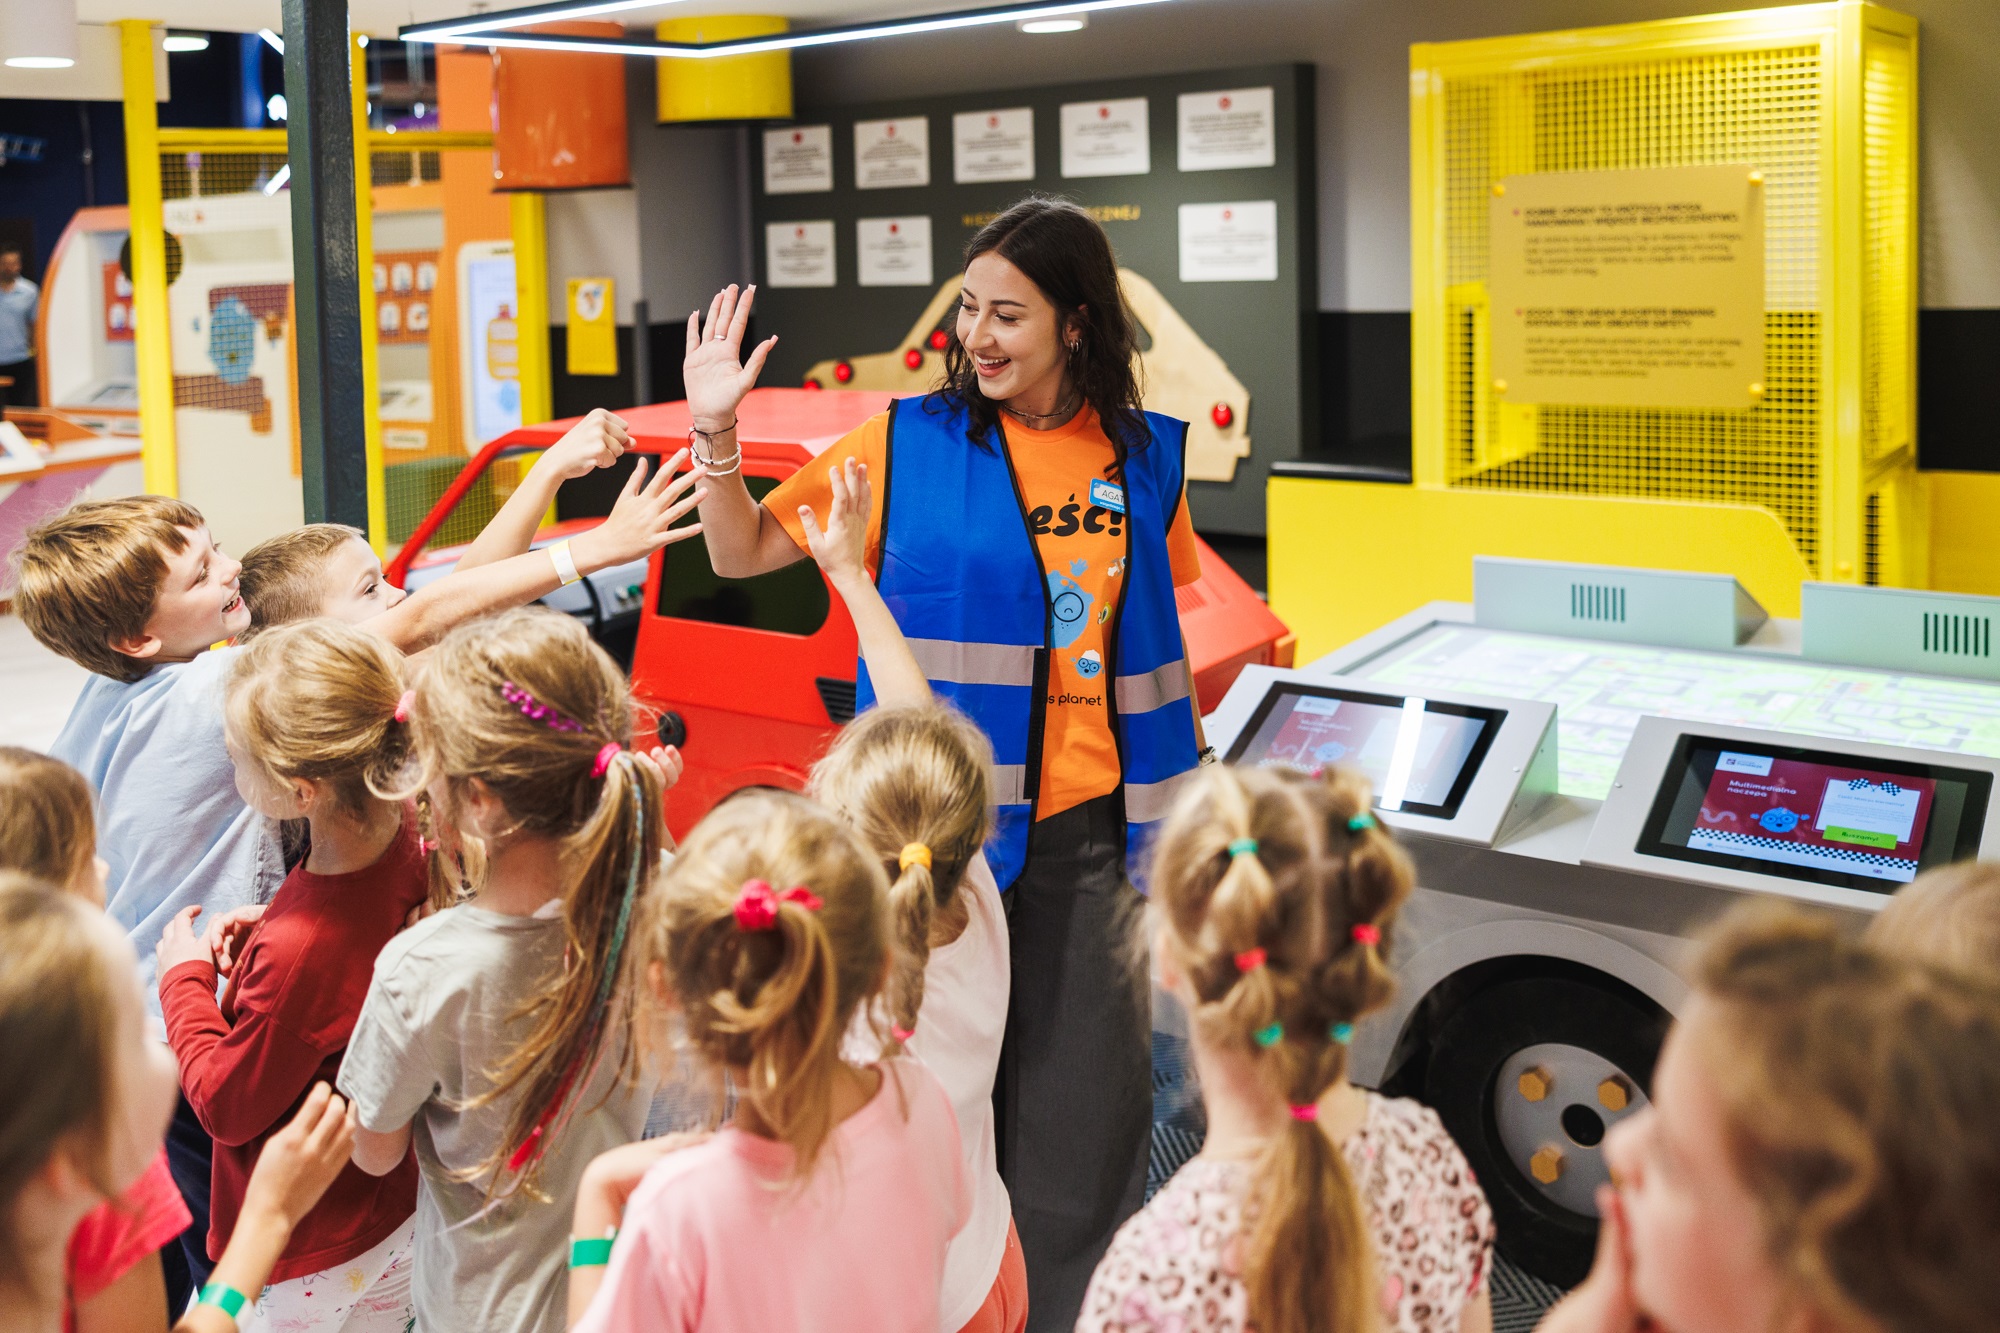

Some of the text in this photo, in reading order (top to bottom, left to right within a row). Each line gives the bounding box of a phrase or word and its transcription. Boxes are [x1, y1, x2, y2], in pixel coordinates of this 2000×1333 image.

[1102, 489, 1124, 504] AGAT
[1028, 493, 1122, 537] eść!
[1058, 693, 1102, 706] planet
[1727, 787, 1768, 797] naczepa
[1729, 780, 1797, 795] Multimedialna
